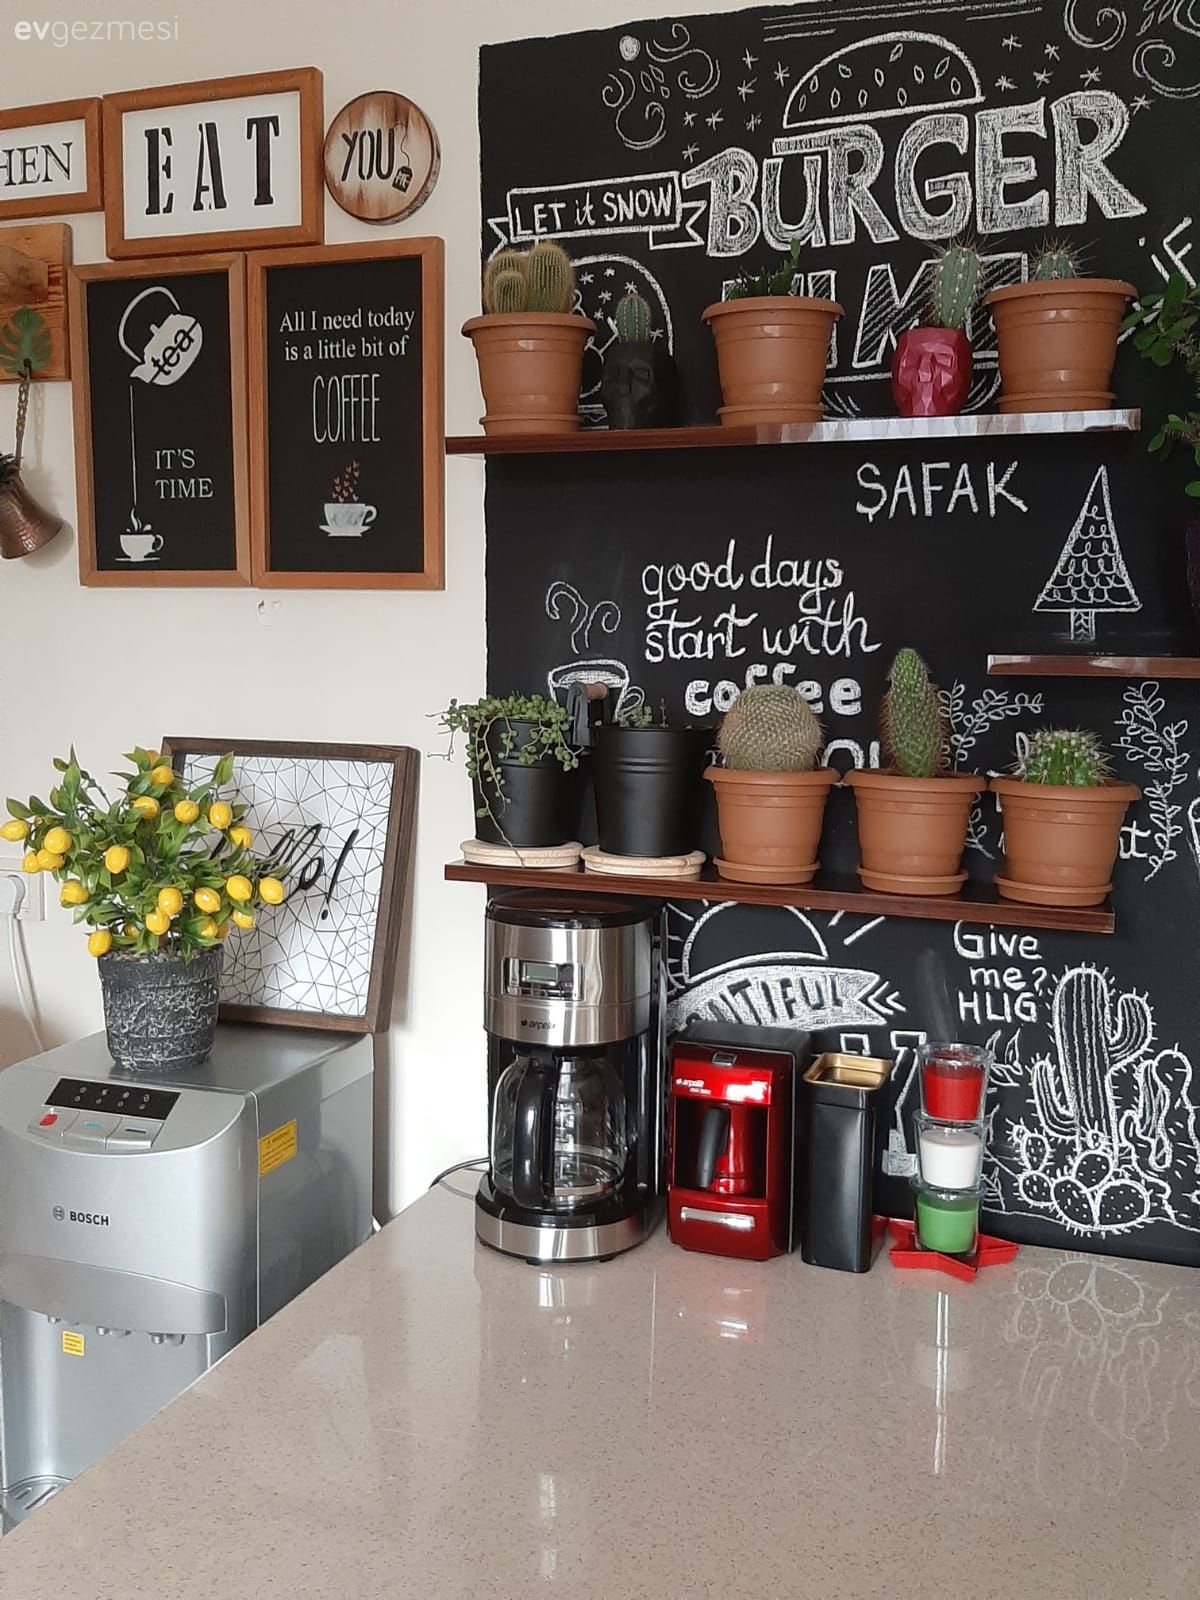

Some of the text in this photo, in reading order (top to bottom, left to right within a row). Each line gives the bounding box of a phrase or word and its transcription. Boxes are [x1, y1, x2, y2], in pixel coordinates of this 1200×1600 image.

[144, 114, 281, 216] EAT
[341, 127, 396, 182] YOU
[682, 90, 1147, 258] BURGER
[515, 182, 673, 236] LET it SNOW
[280, 305, 416, 333] All I need today
[151, 329, 195, 376] tea
[284, 334, 410, 361] is a little bit of
[312, 373, 381, 444] COFFEE
[155, 448, 196, 470] IT'S
[155, 477, 214, 500] TIME
[856, 460, 1029, 523] ŞAFAK
[642, 533, 844, 620] good days
[645, 591, 882, 662] start with
[953, 920, 1043, 960] Give
[969, 966, 1048, 992] me?
[69, 1210, 110, 1227] BOSCH
